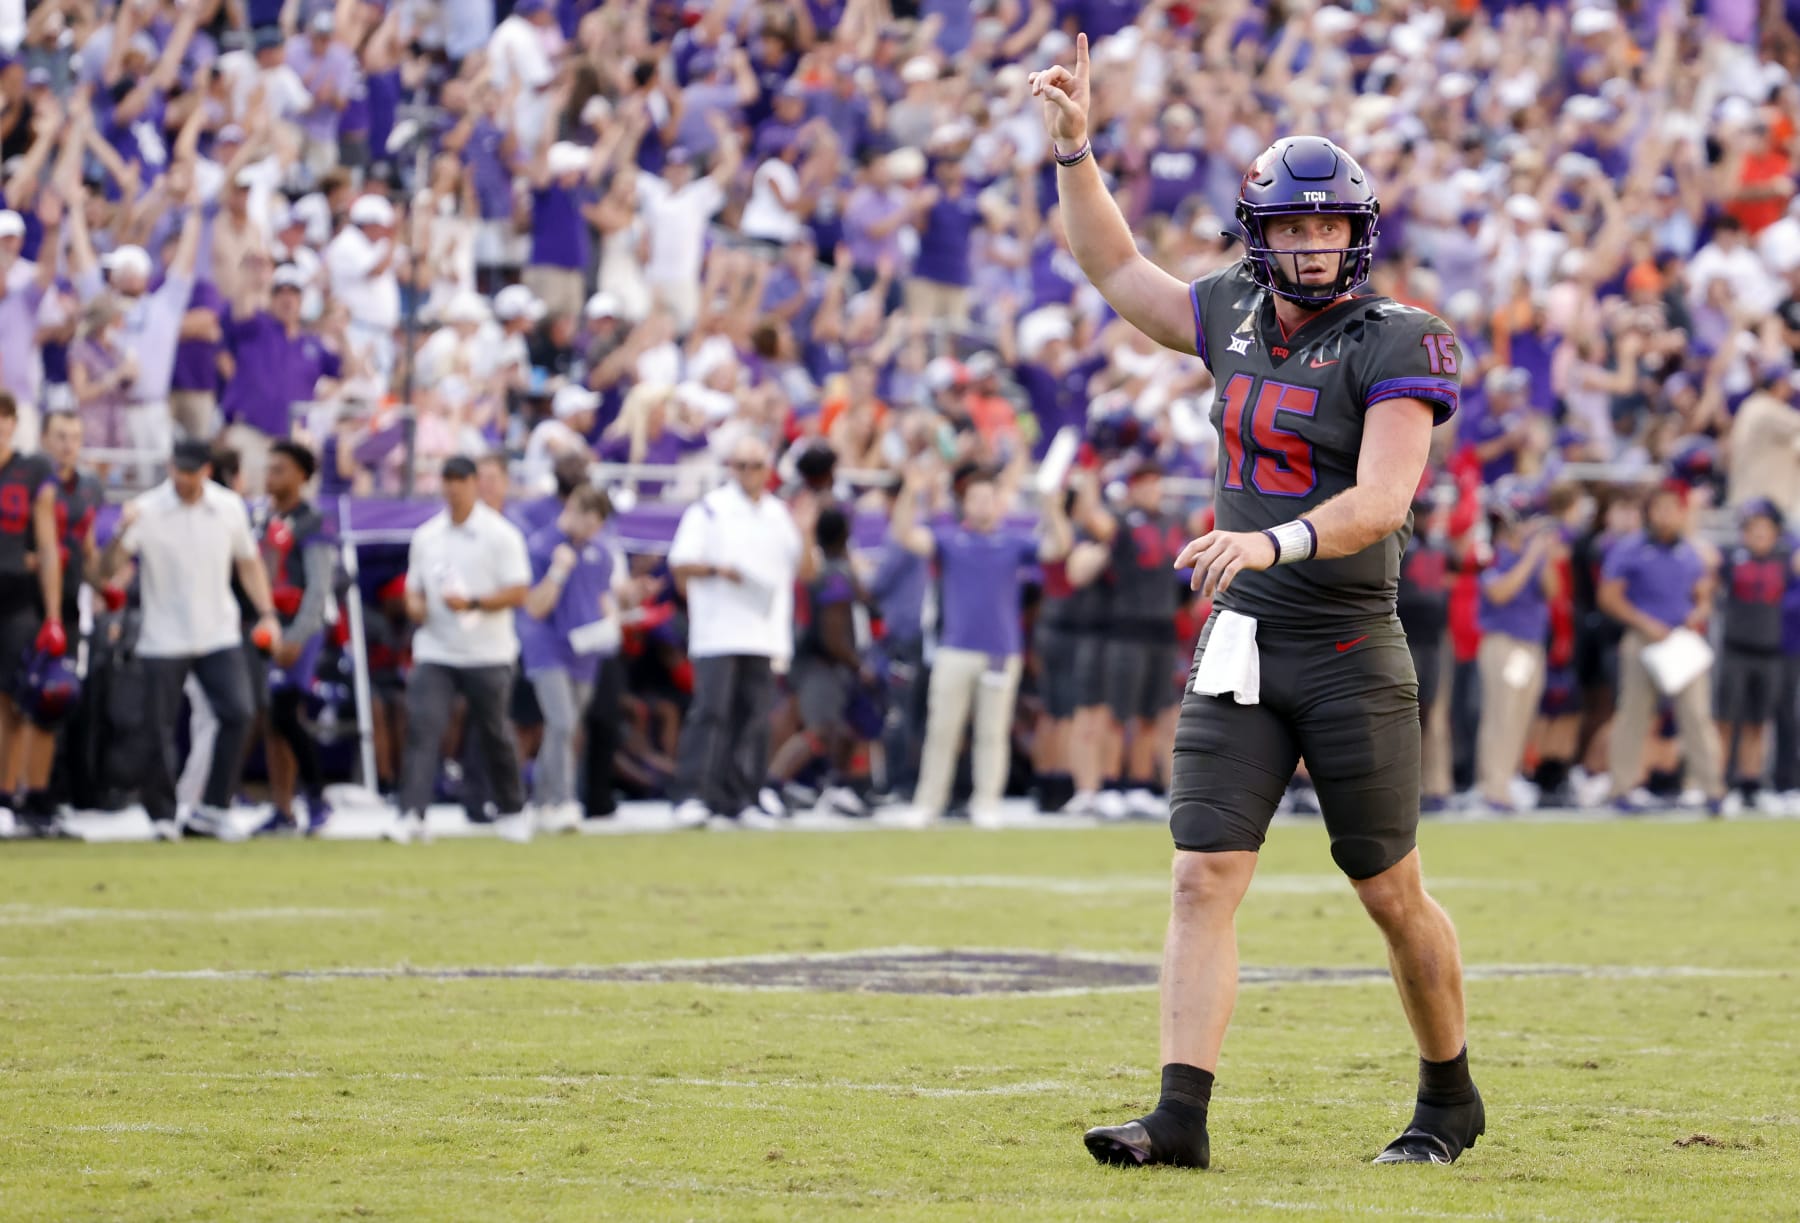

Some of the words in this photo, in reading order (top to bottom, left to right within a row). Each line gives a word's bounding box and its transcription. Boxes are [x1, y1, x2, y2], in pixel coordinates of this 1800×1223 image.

[1303, 191, 1326, 202] TCU
[1271, 346, 1290, 359] TCU
[1421, 333, 1458, 375] 15
[1222, 372, 1319, 497] 15
